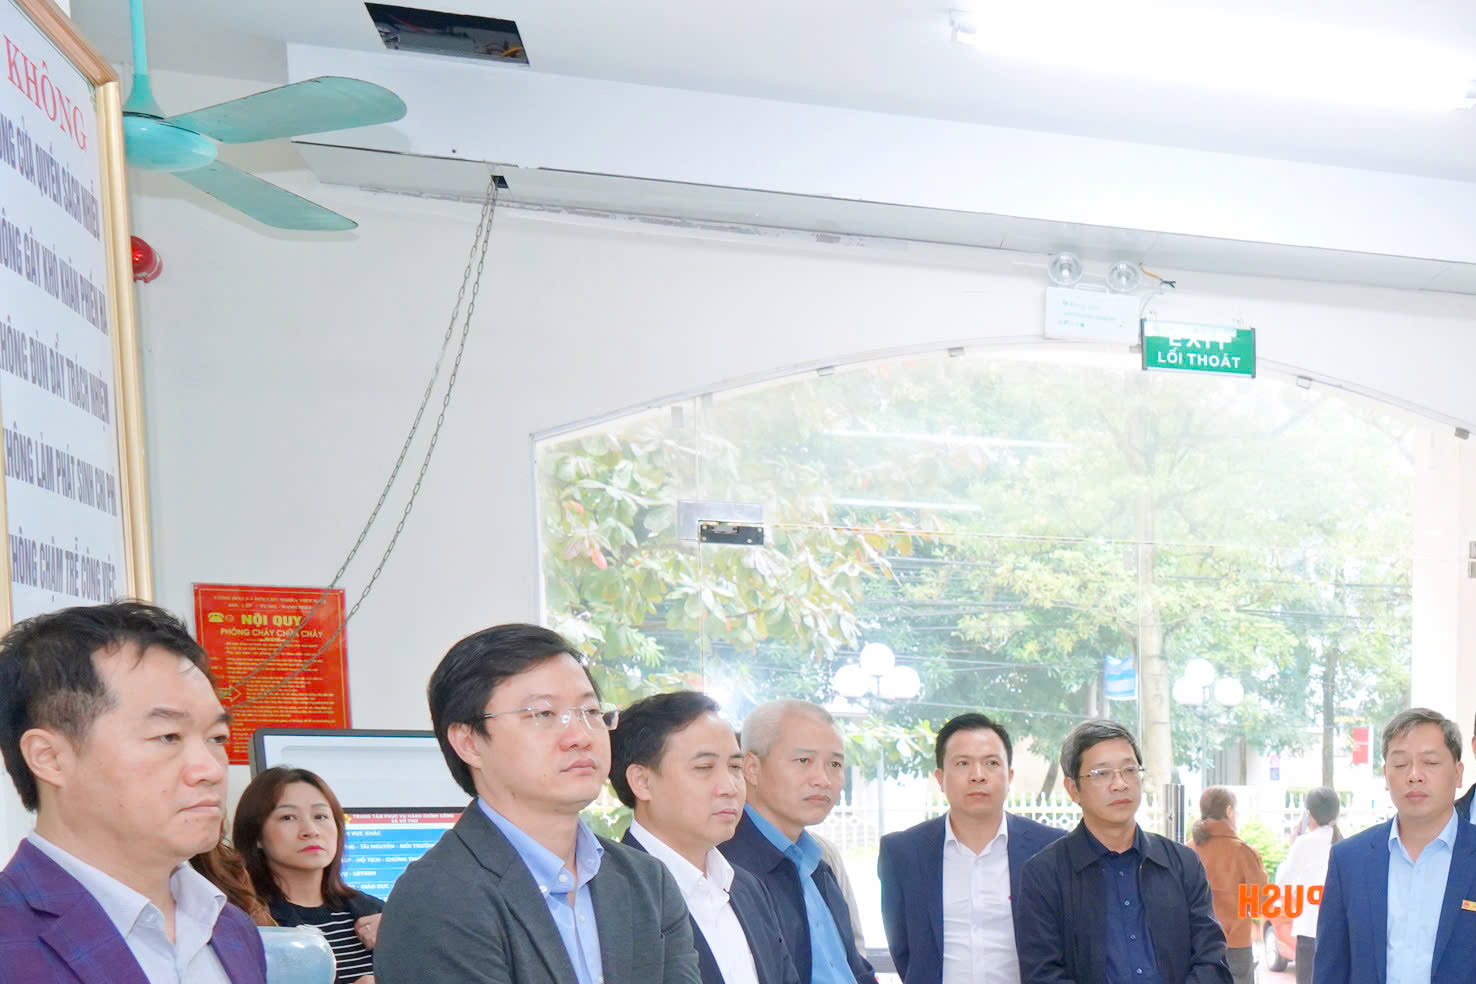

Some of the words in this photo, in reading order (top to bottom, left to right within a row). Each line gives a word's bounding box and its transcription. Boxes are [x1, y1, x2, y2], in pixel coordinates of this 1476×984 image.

[3, 34, 86, 151] KHÔNG
[0, 207, 22, 276] ÔNG
[23, 226, 41, 287] GÂY
[41, 243, 59, 299] KHÓ
[29, 330, 49, 391] ĐÙN
[49, 332, 65, 400] ĐẨY
[66, 353, 90, 413] TRÁCH
[1157, 347, 1183, 364] LỐI
[1187, 352, 1241, 368] THOÁT
[35, 432, 55, 492] LÀM
[56, 444, 76, 500] PHÁT
[77, 458, 95, 507] SINH
[40, 536, 63, 602] CHẬM
[65, 536, 79, 597] TRỄ
[81, 546, 101, 601] CÔNG
[220, 627, 250, 636] PHÒNG
[252, 628, 274, 637] CHÁY
[300, 629, 323, 639] CHÁY
[241, 612, 268, 627] NỘI
[272, 615, 302, 626] QUY
